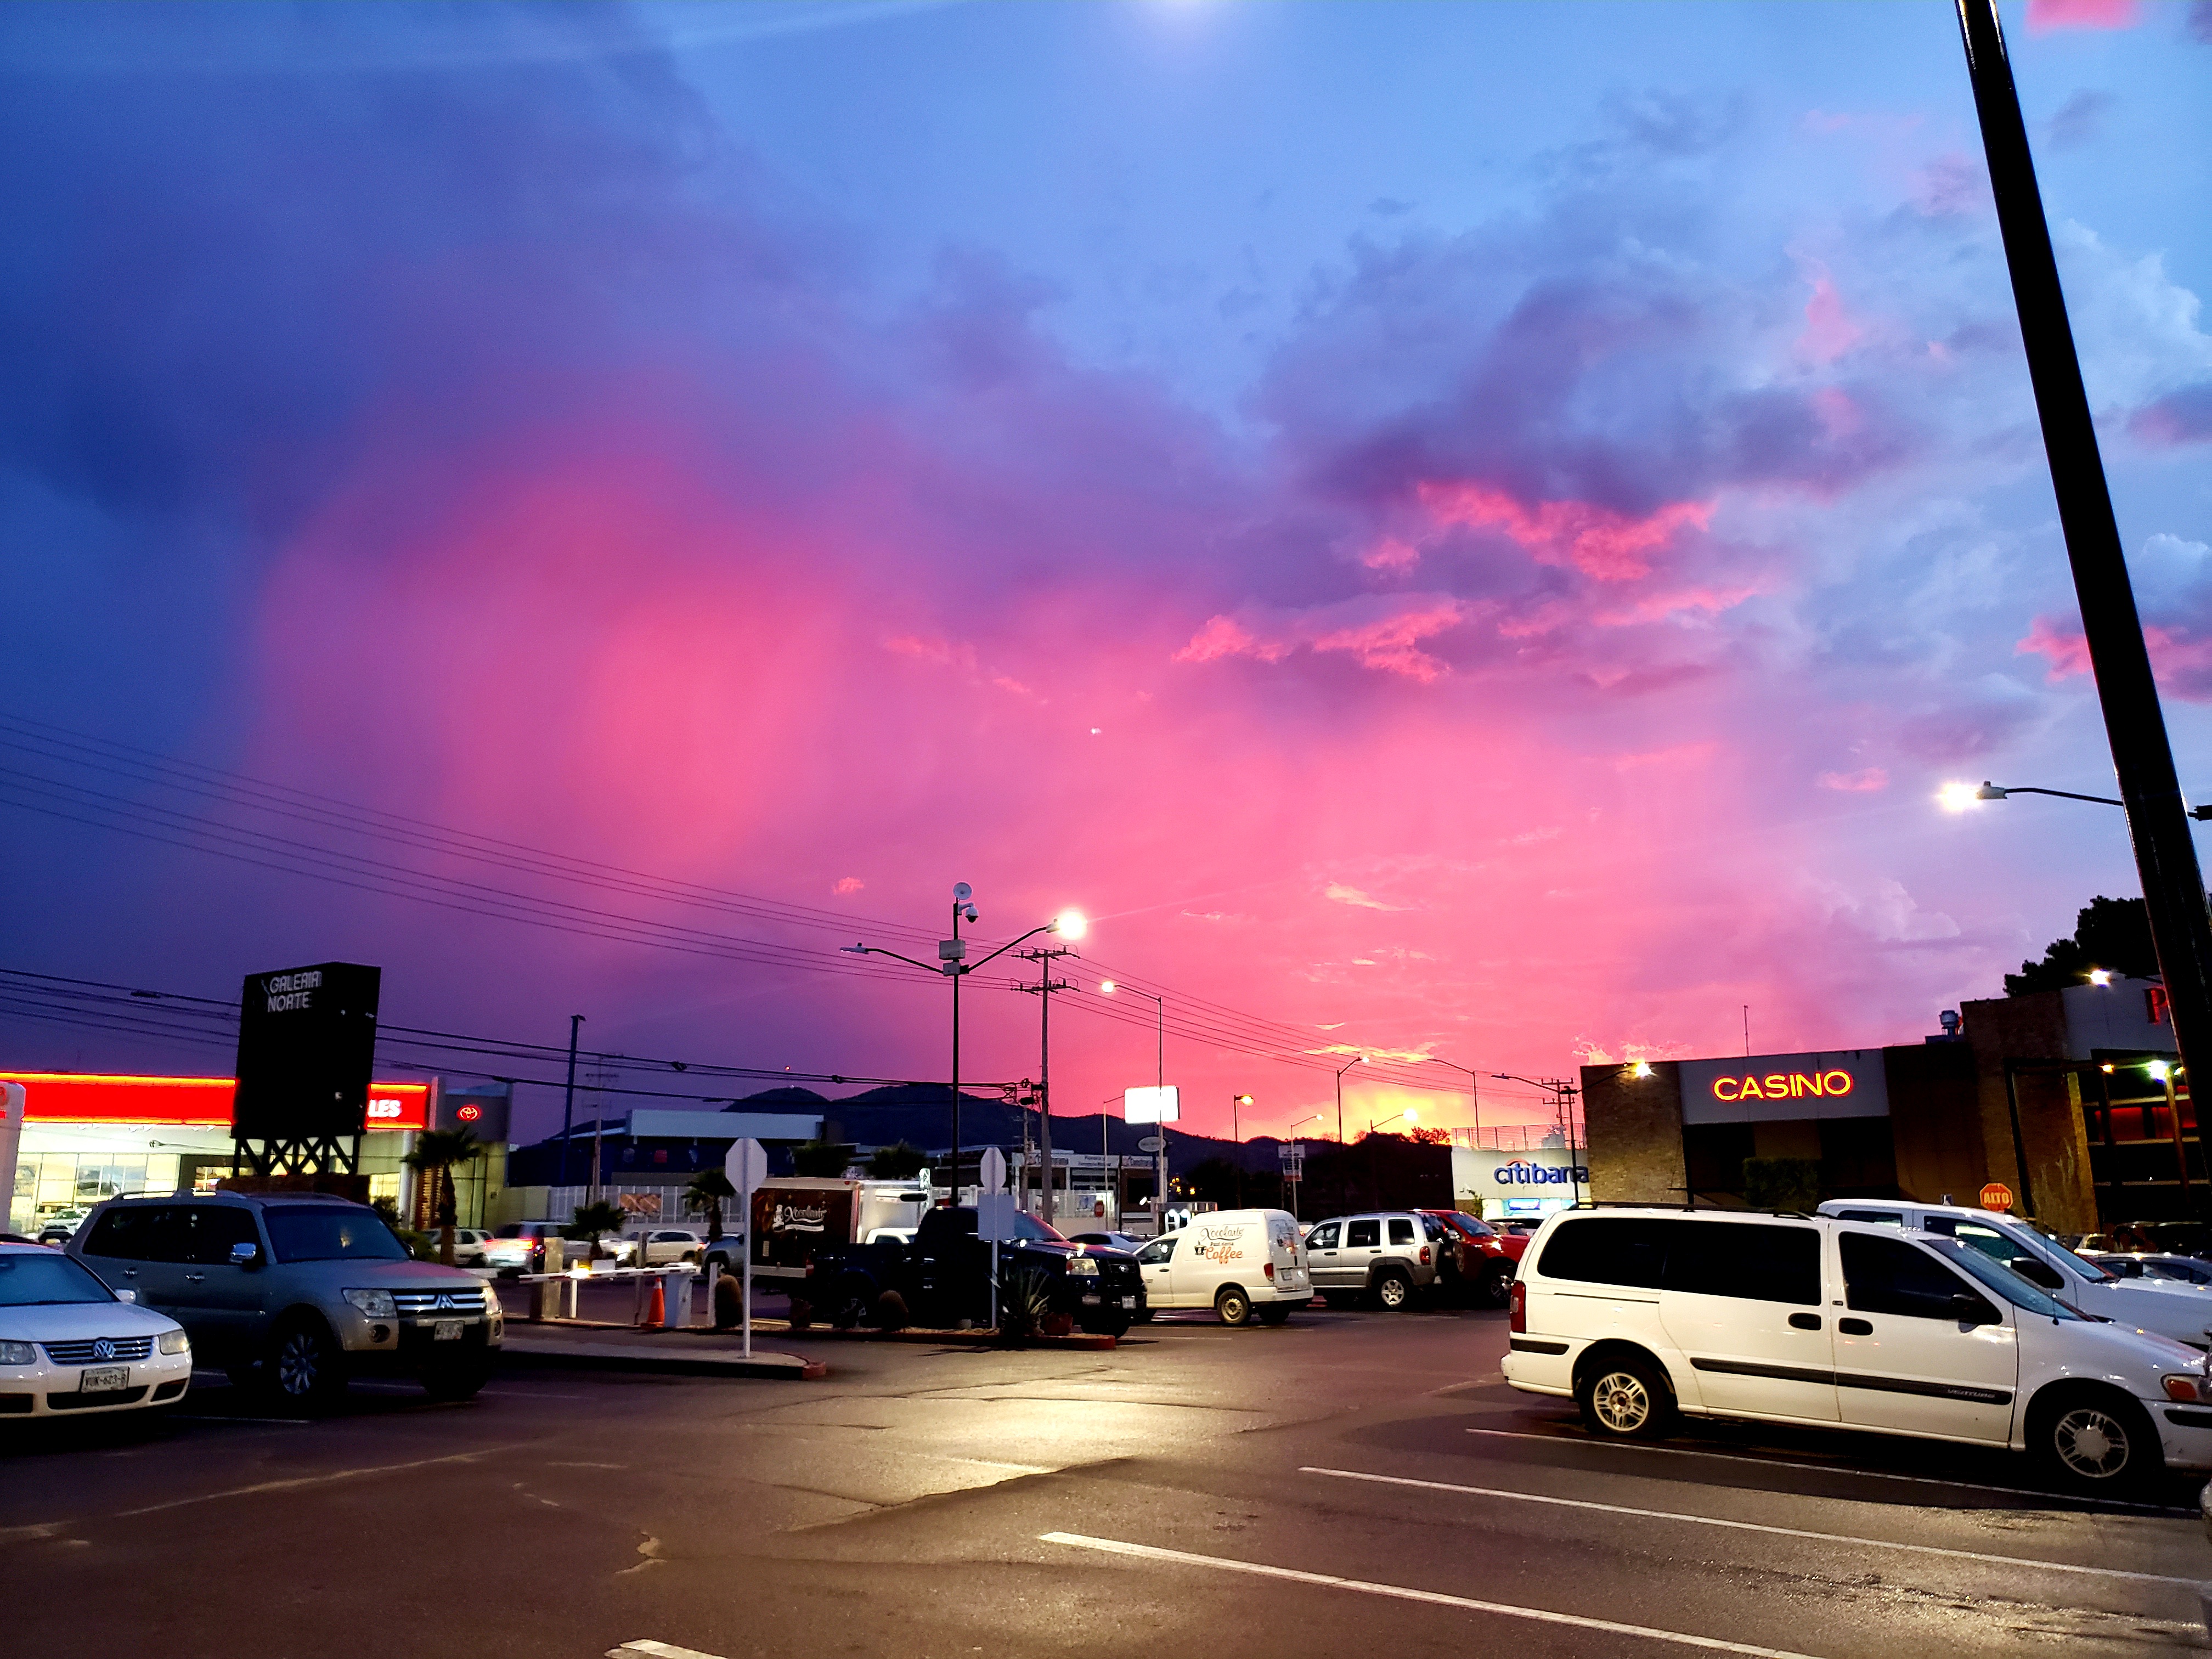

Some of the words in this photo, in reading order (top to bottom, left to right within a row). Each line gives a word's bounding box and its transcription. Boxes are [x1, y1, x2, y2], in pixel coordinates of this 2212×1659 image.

[1713, 1070, 1852, 1101] CASINO
[1984, 1192, 2010, 1204] ALTO
[1206, 1246, 1243, 1264] Coffee
